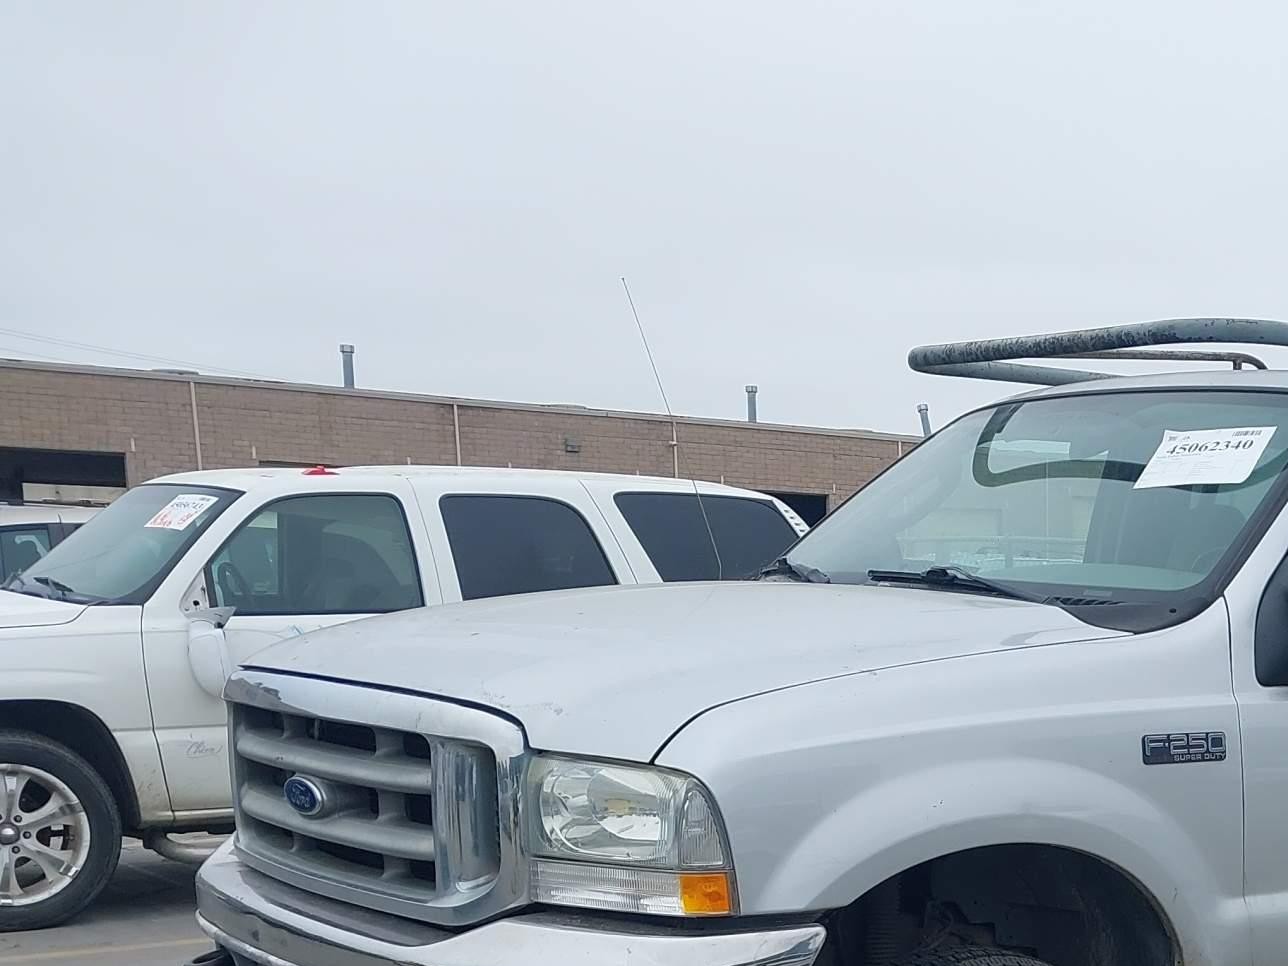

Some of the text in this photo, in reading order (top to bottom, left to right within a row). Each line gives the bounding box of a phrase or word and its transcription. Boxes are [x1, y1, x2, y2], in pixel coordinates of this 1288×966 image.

[1166, 439, 1255, 455] 45062340
[1173, 752, 1226, 762] SUPER DUTY
